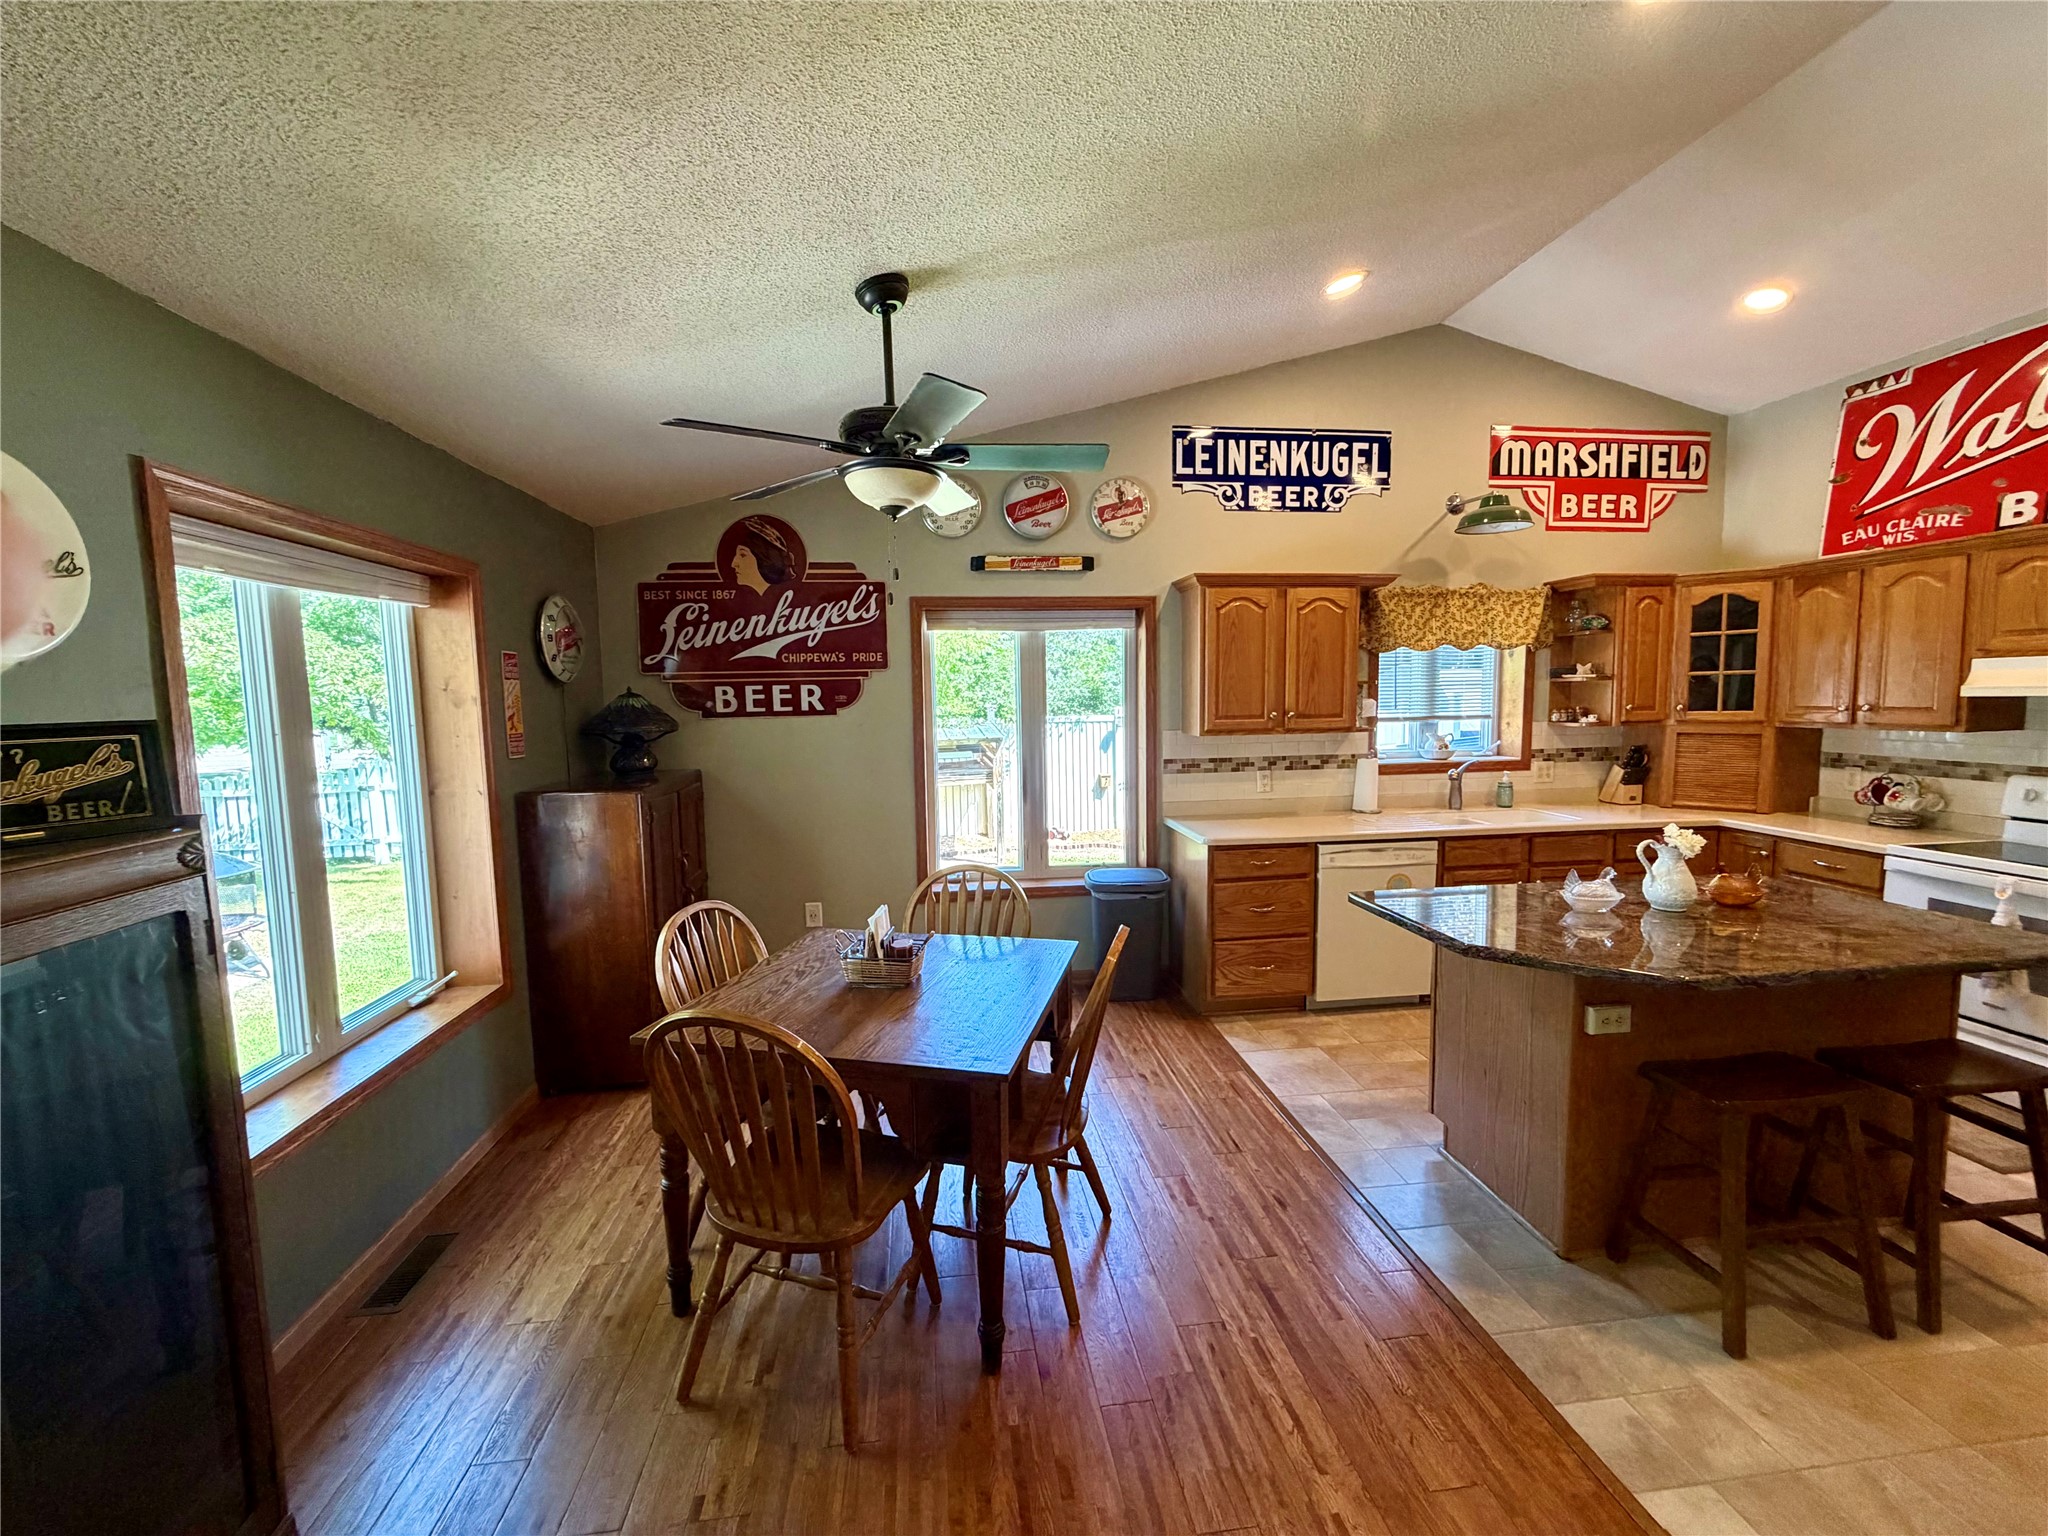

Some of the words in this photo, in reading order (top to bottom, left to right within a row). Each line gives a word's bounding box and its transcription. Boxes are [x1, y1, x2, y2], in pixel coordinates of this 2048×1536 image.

[1176, 438, 1388, 478] LEINENKUGEL
[1499, 440, 1707, 480] MARSHFIELD
[1249, 485, 1319, 508] BEER
[1561, 493, 1638, 519] BEER
[1031, 518, 1052, 528] Beer
[1841, 523, 1880, 546] EAU
[1885, 513, 1964, 534] CLAIRE
[1882, 531, 1919, 546] WIS.
[643, 590, 671, 601] BEST
[675, 590, 708, 600] SINCE
[711, 589, 736, 600] 1867
[643, 584, 881, 665] Leinenkugel's
[781, 651, 846, 664] CHIPPEWA'S
[852, 652, 884, 663] PRIDE
[713, 684, 826, 714] BEER
